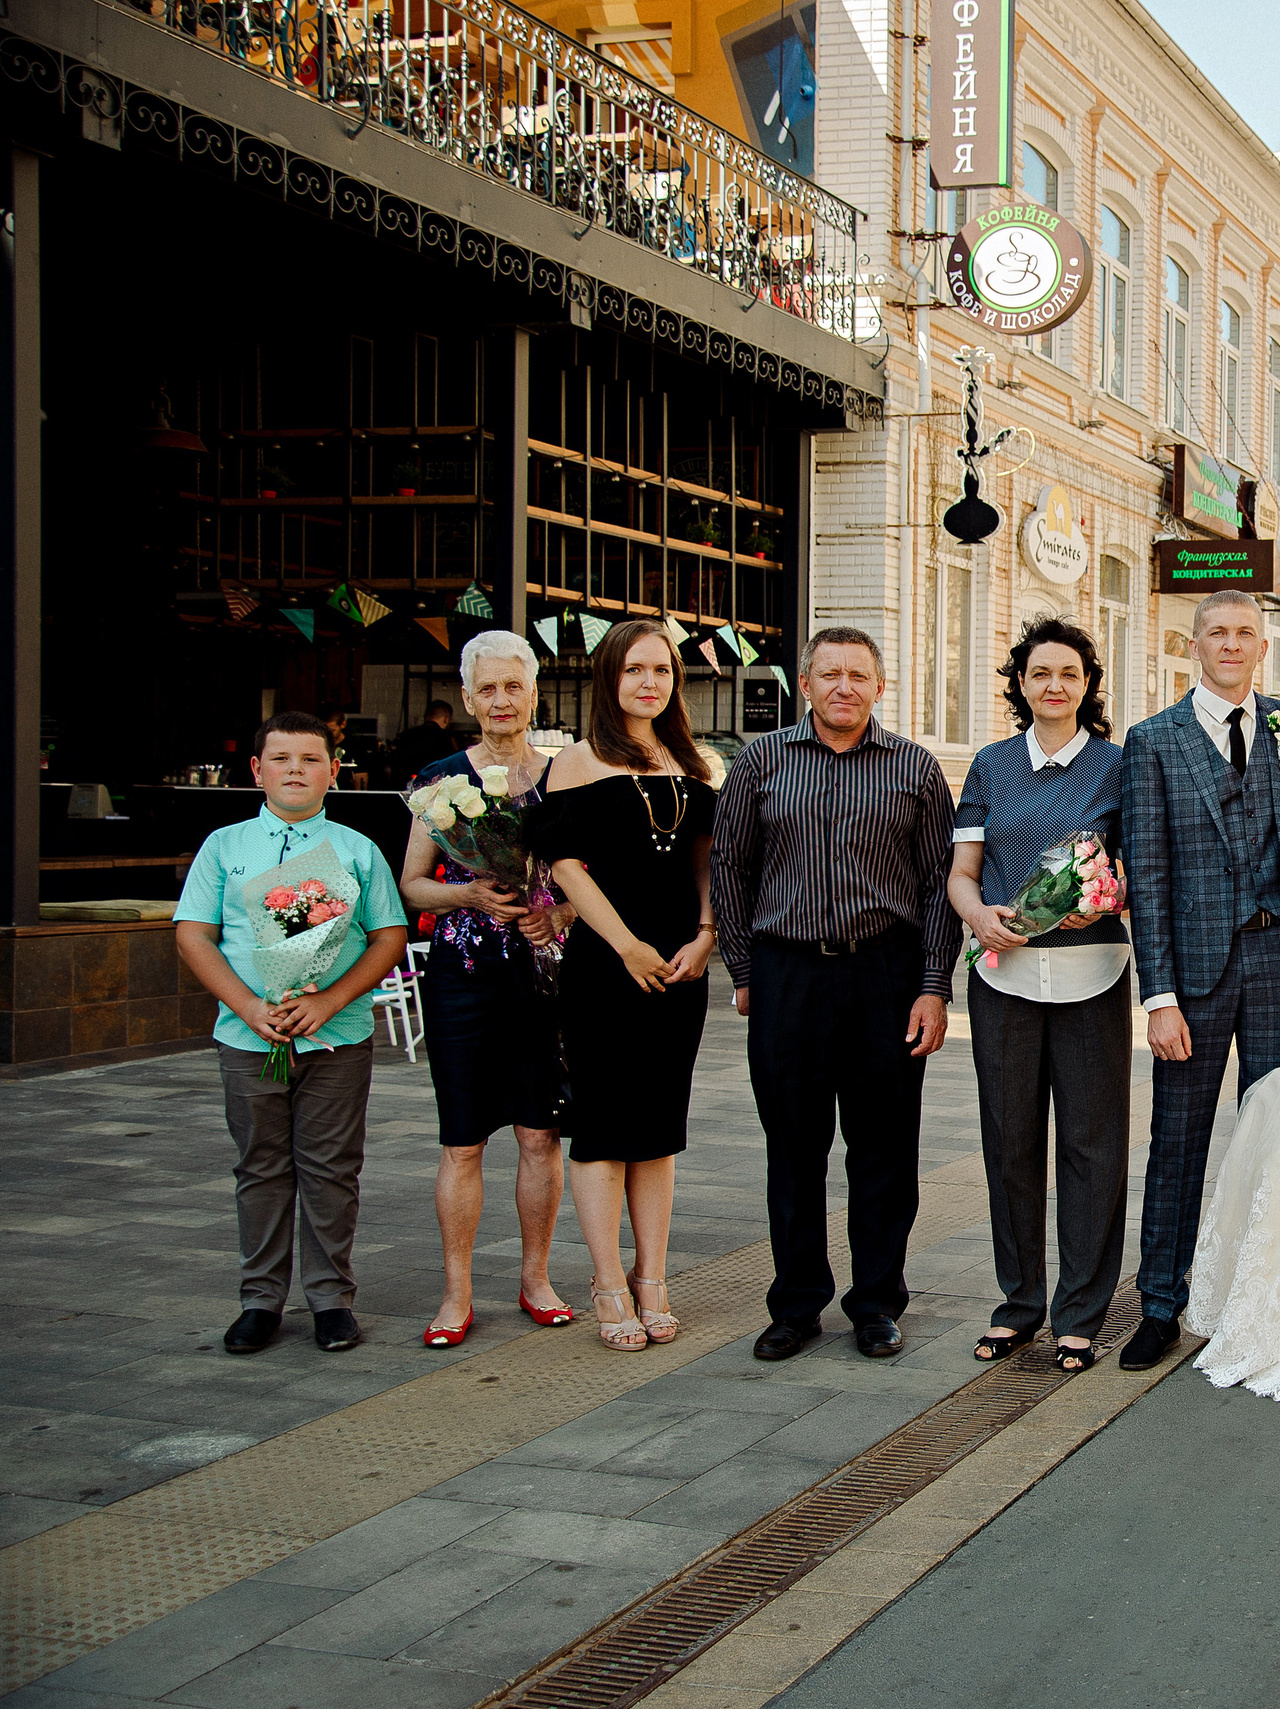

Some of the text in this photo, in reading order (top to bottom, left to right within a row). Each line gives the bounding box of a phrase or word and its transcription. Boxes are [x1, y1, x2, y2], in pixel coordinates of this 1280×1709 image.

[952, 0, 979, 174] ФЕЙНЯ
[976, 205, 1060, 233] КОФЕЙНЯ
[949, 269, 1081, 330] КОФЕ И ШОКОЛАД
[1036, 519, 1081, 563] Emirates
[1177, 549, 1248, 567] Французская
[1172, 568, 1253, 580] КОНДИТЕРСКАЯ
